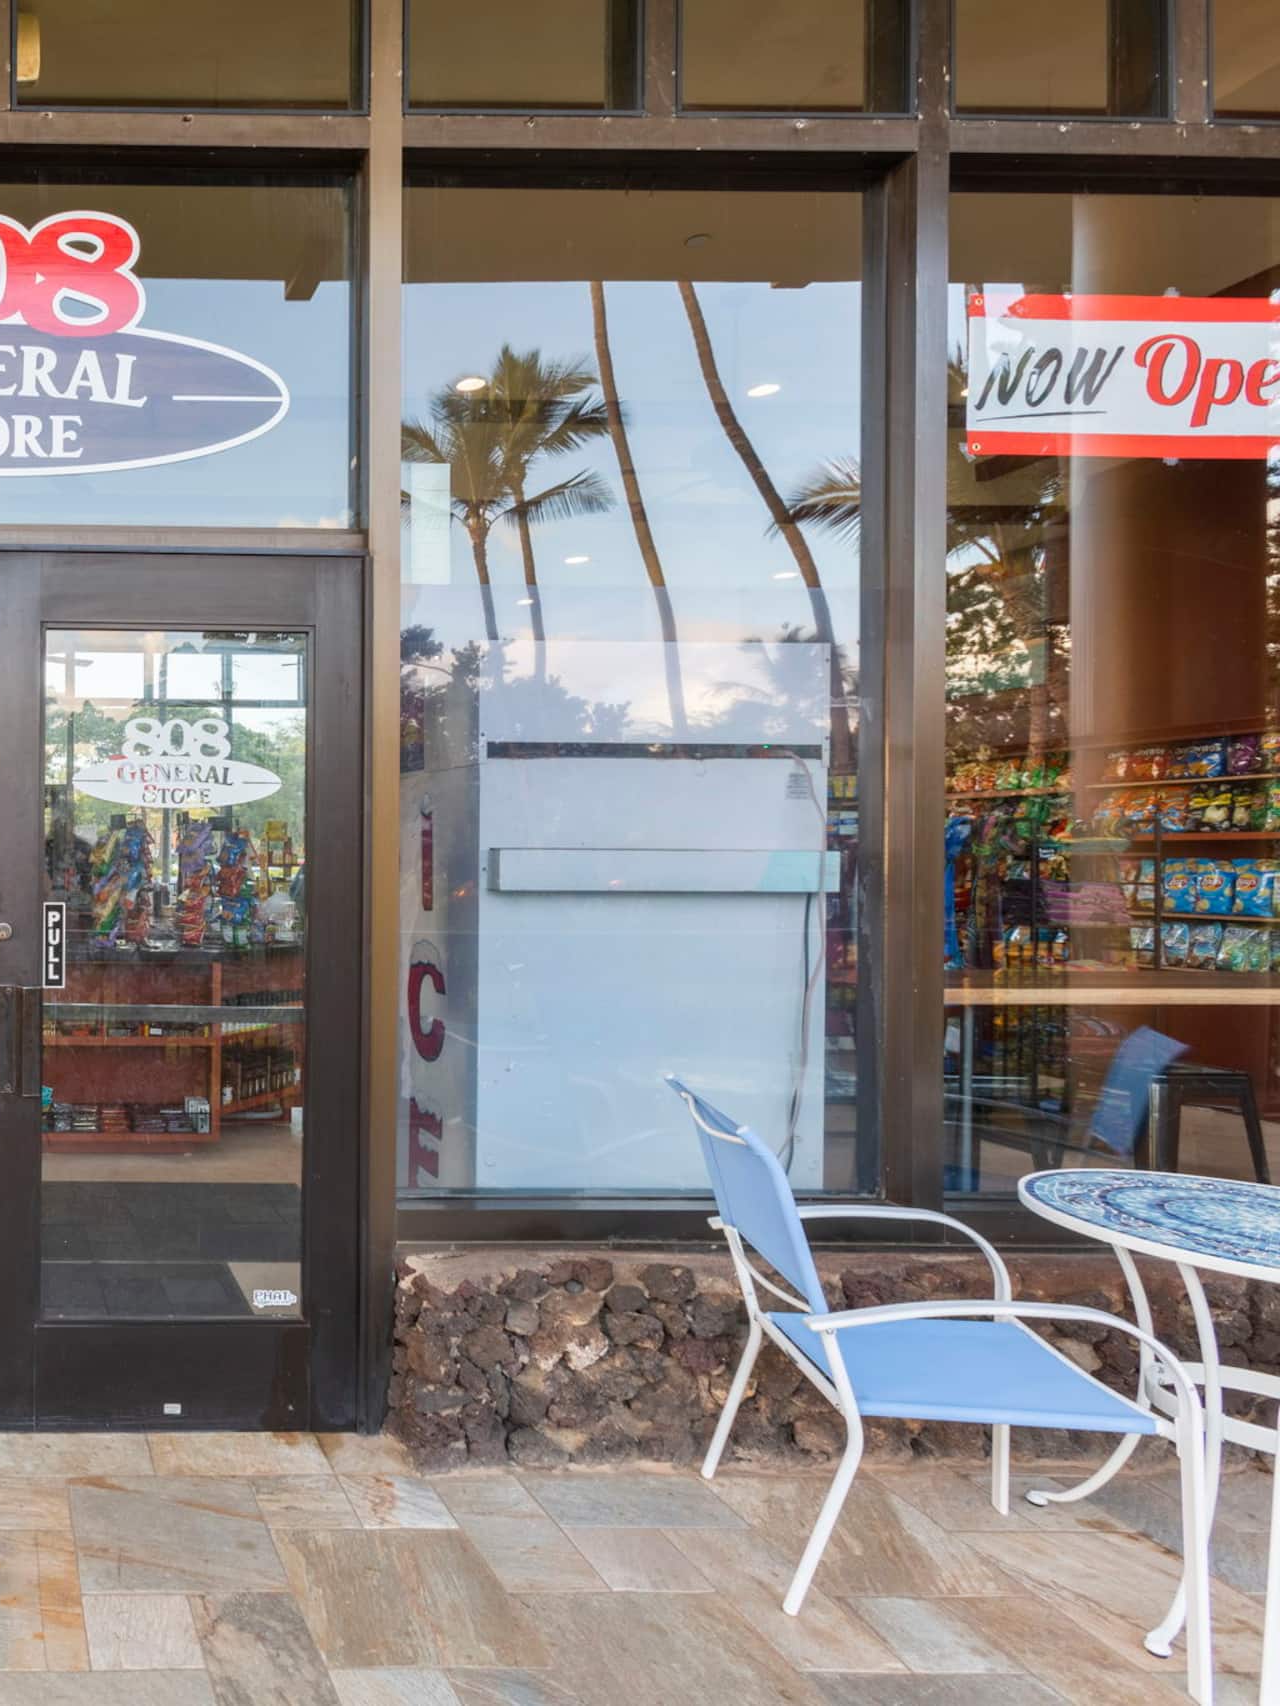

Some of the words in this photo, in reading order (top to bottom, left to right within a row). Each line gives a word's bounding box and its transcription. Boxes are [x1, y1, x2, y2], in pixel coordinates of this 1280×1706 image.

[973, 345, 1125, 411] NOW
[121, 718, 232, 760] 808
[116, 761, 235, 786] GENERAL
[47, 910, 61, 980] PULL
